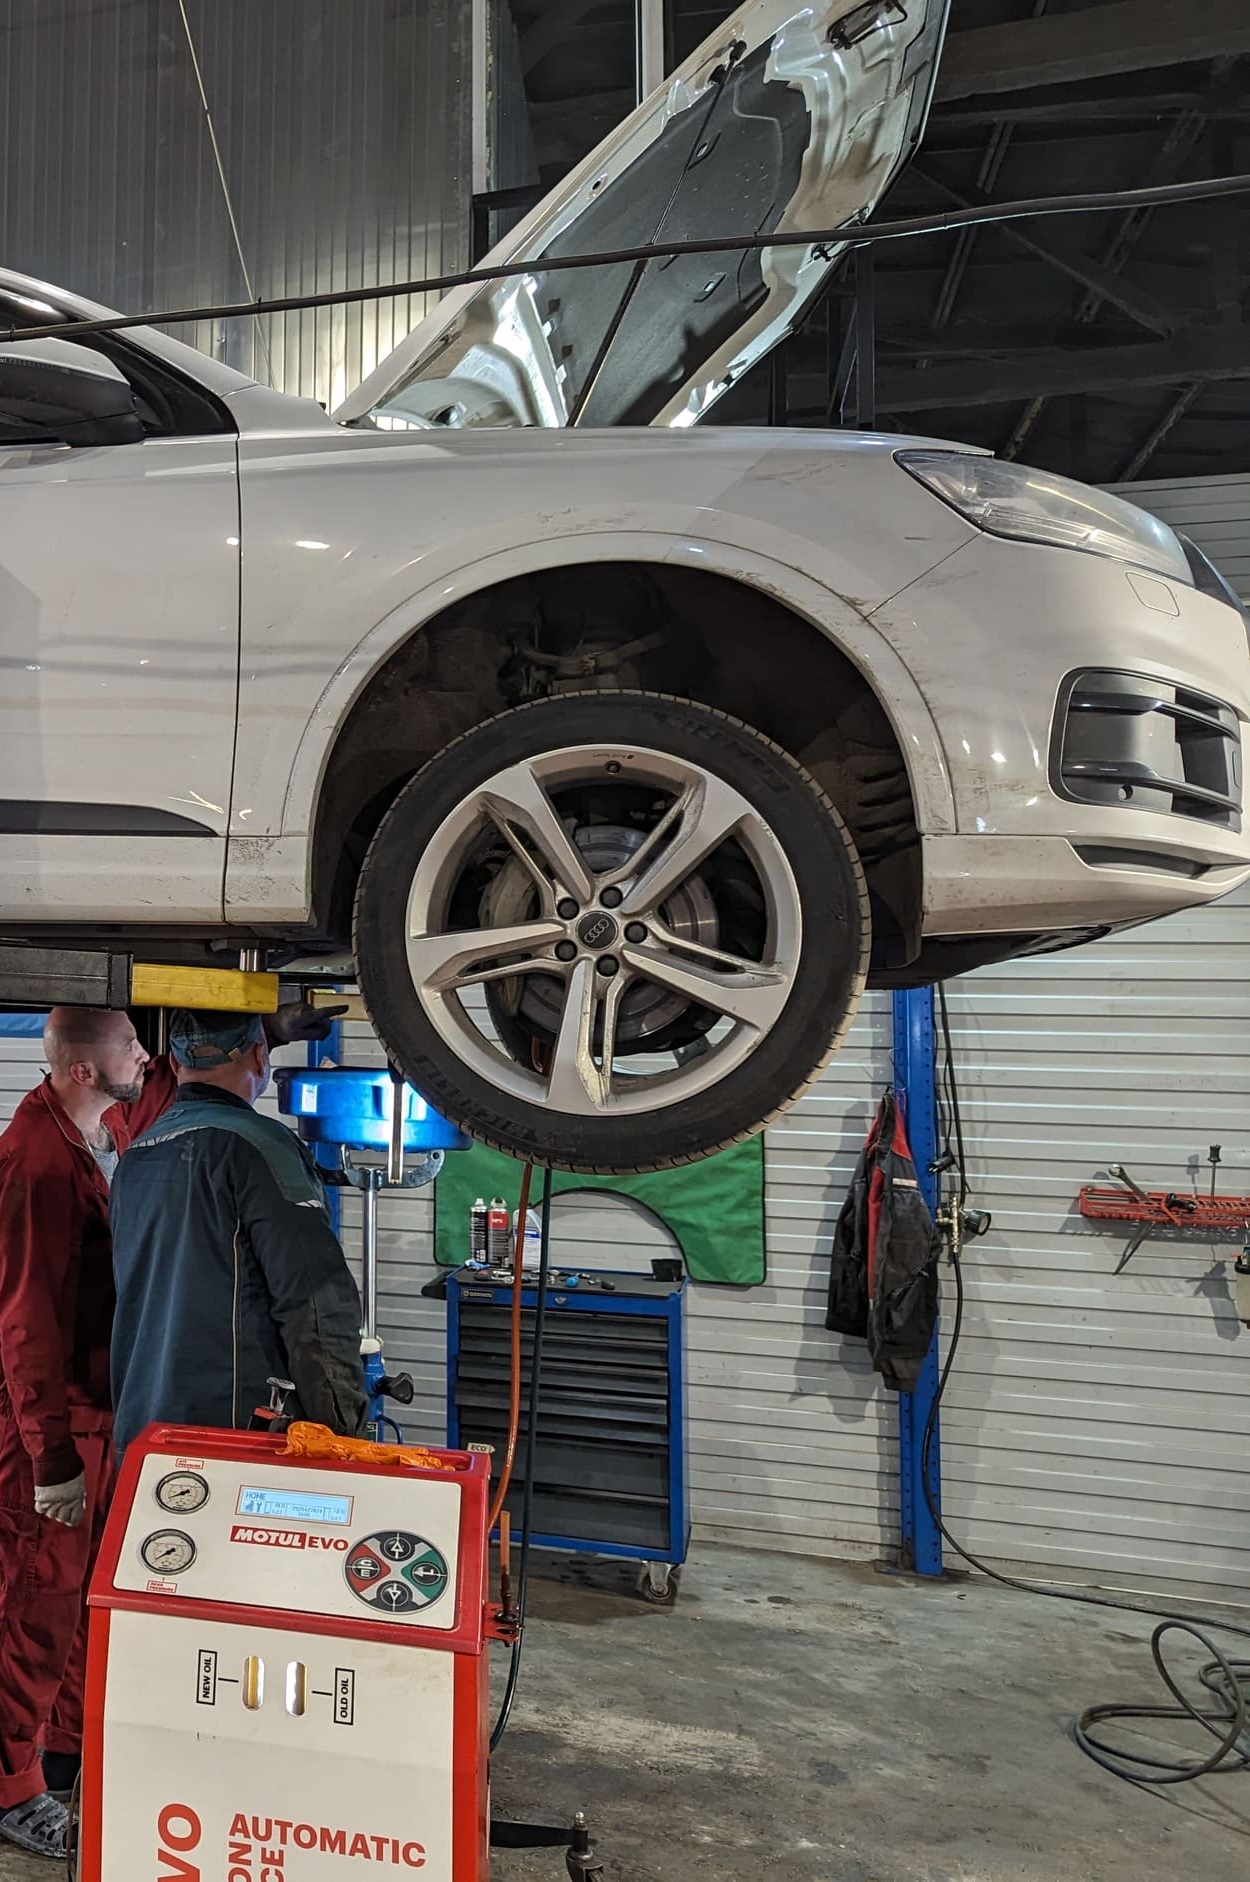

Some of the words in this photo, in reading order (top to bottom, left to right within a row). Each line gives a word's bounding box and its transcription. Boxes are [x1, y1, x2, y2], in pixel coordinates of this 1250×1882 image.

[245, 1490, 266, 1500] HOME
[234, 1528, 303, 1548] MOTUL
[307, 1535, 349, 1551] EVO
[203, 1656, 212, 1674] OIL
[202, 1675, 212, 1699] NEW
[341, 1677, 350, 1695] OIL
[340, 1695, 349, 1718] OLD
[157, 1803, 202, 1882] VO
[228, 1812, 427, 1868] AUTOMATIC
